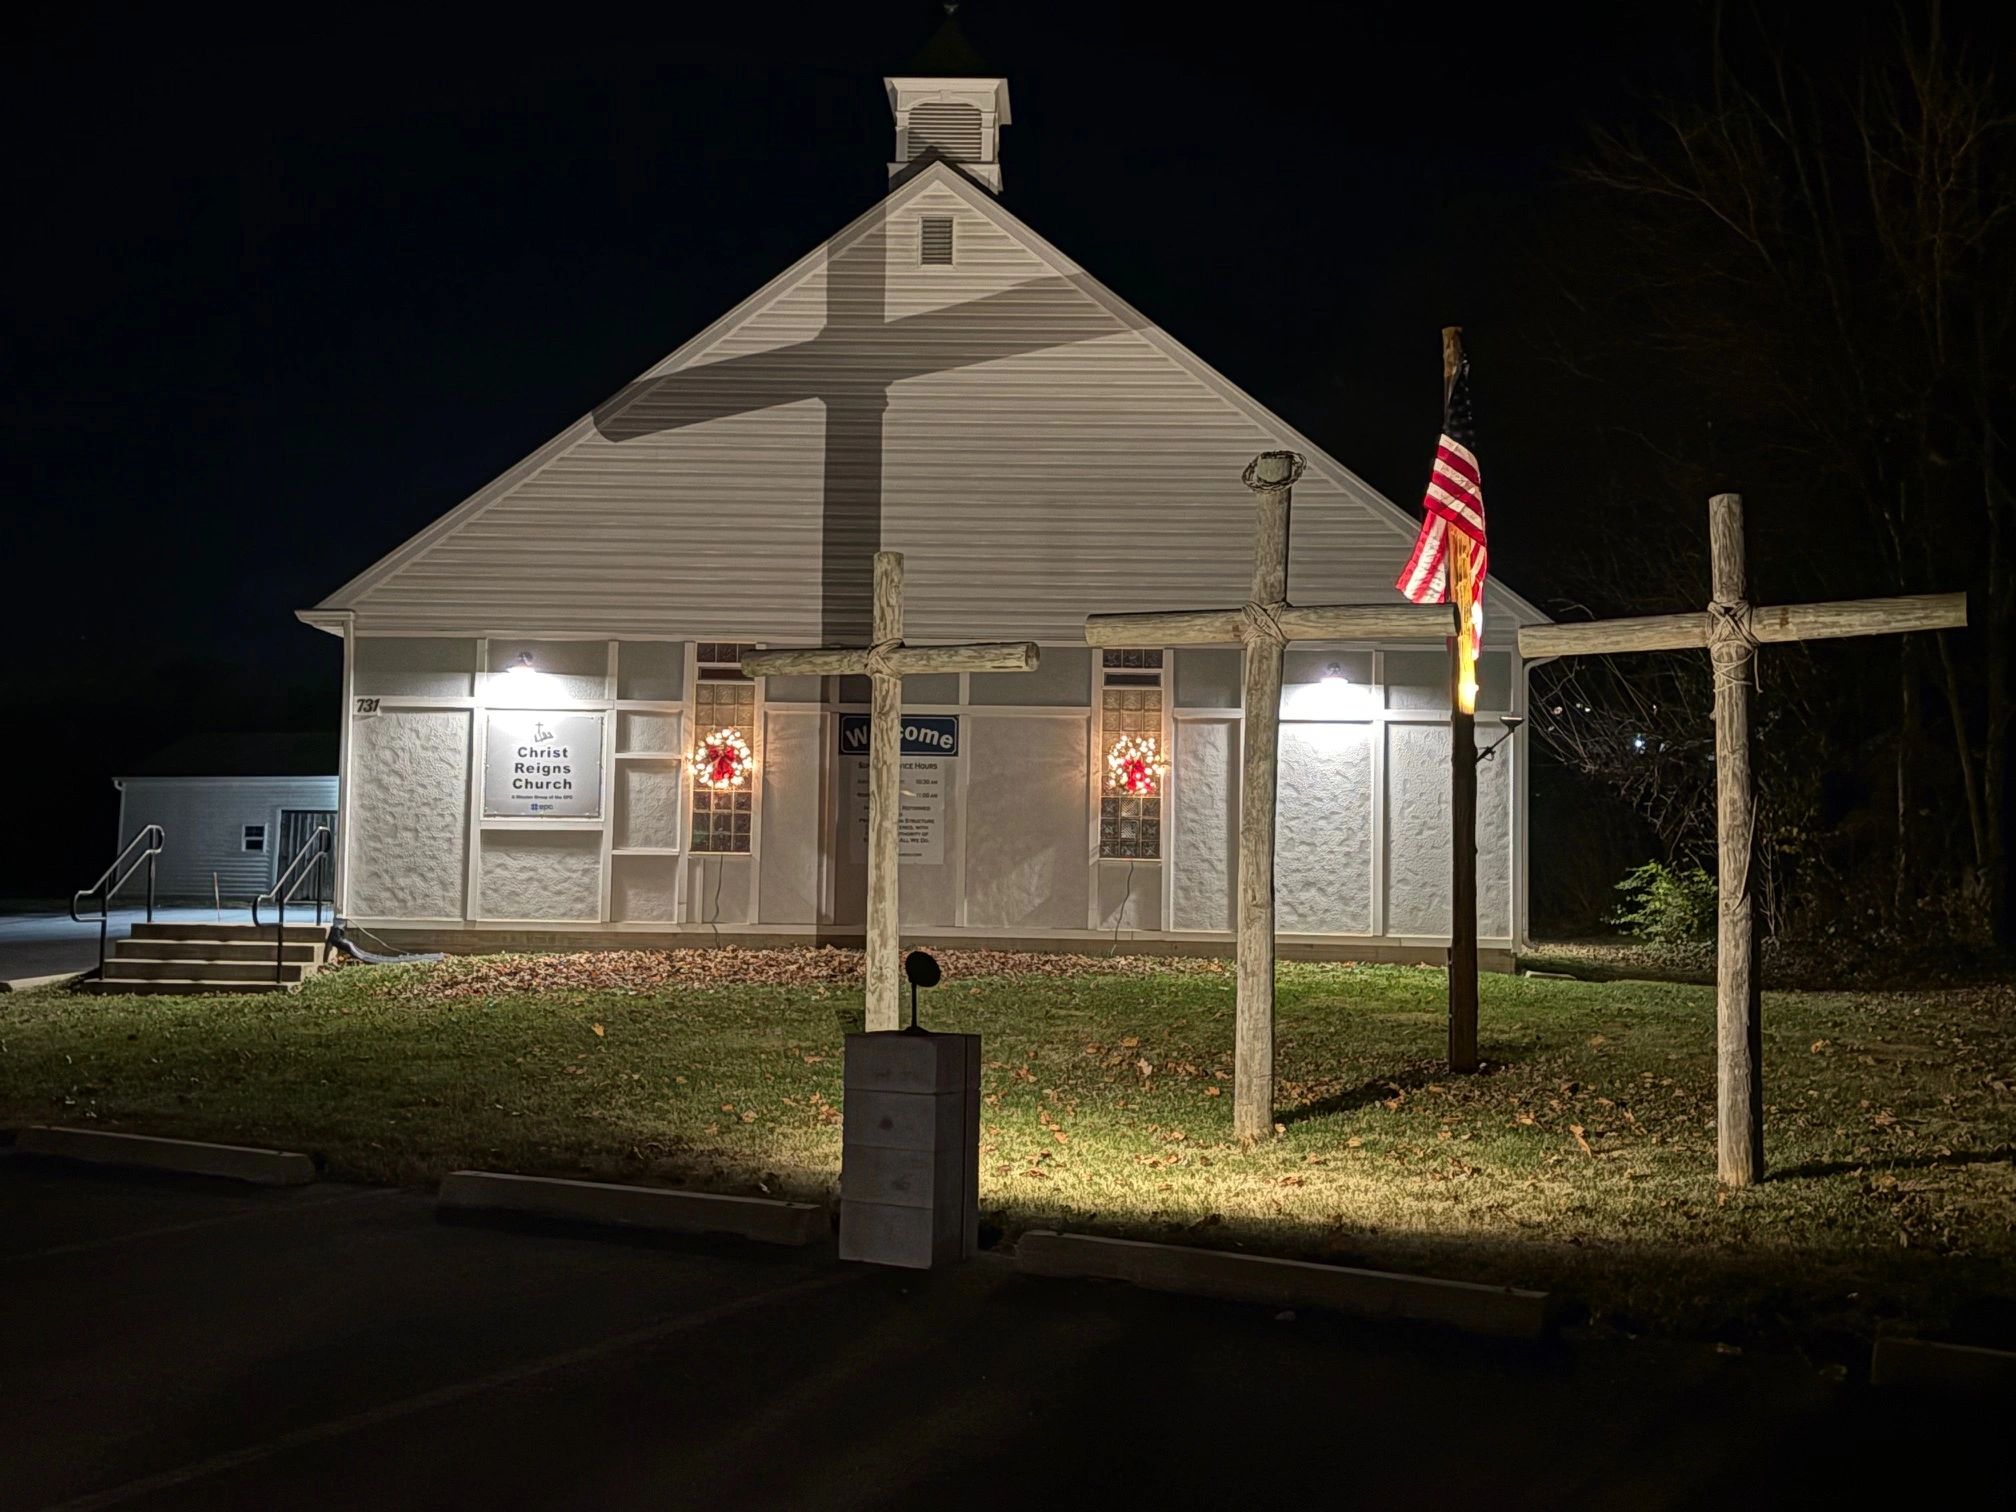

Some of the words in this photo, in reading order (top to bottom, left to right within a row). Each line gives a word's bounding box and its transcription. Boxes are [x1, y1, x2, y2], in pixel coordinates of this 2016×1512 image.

[357, 698, 380, 713] 731
[845, 726, 954, 749] Wome
[518, 746, 568, 758] Christ
[515, 763, 571, 776] Reigns
[512, 778, 572, 789] Church
